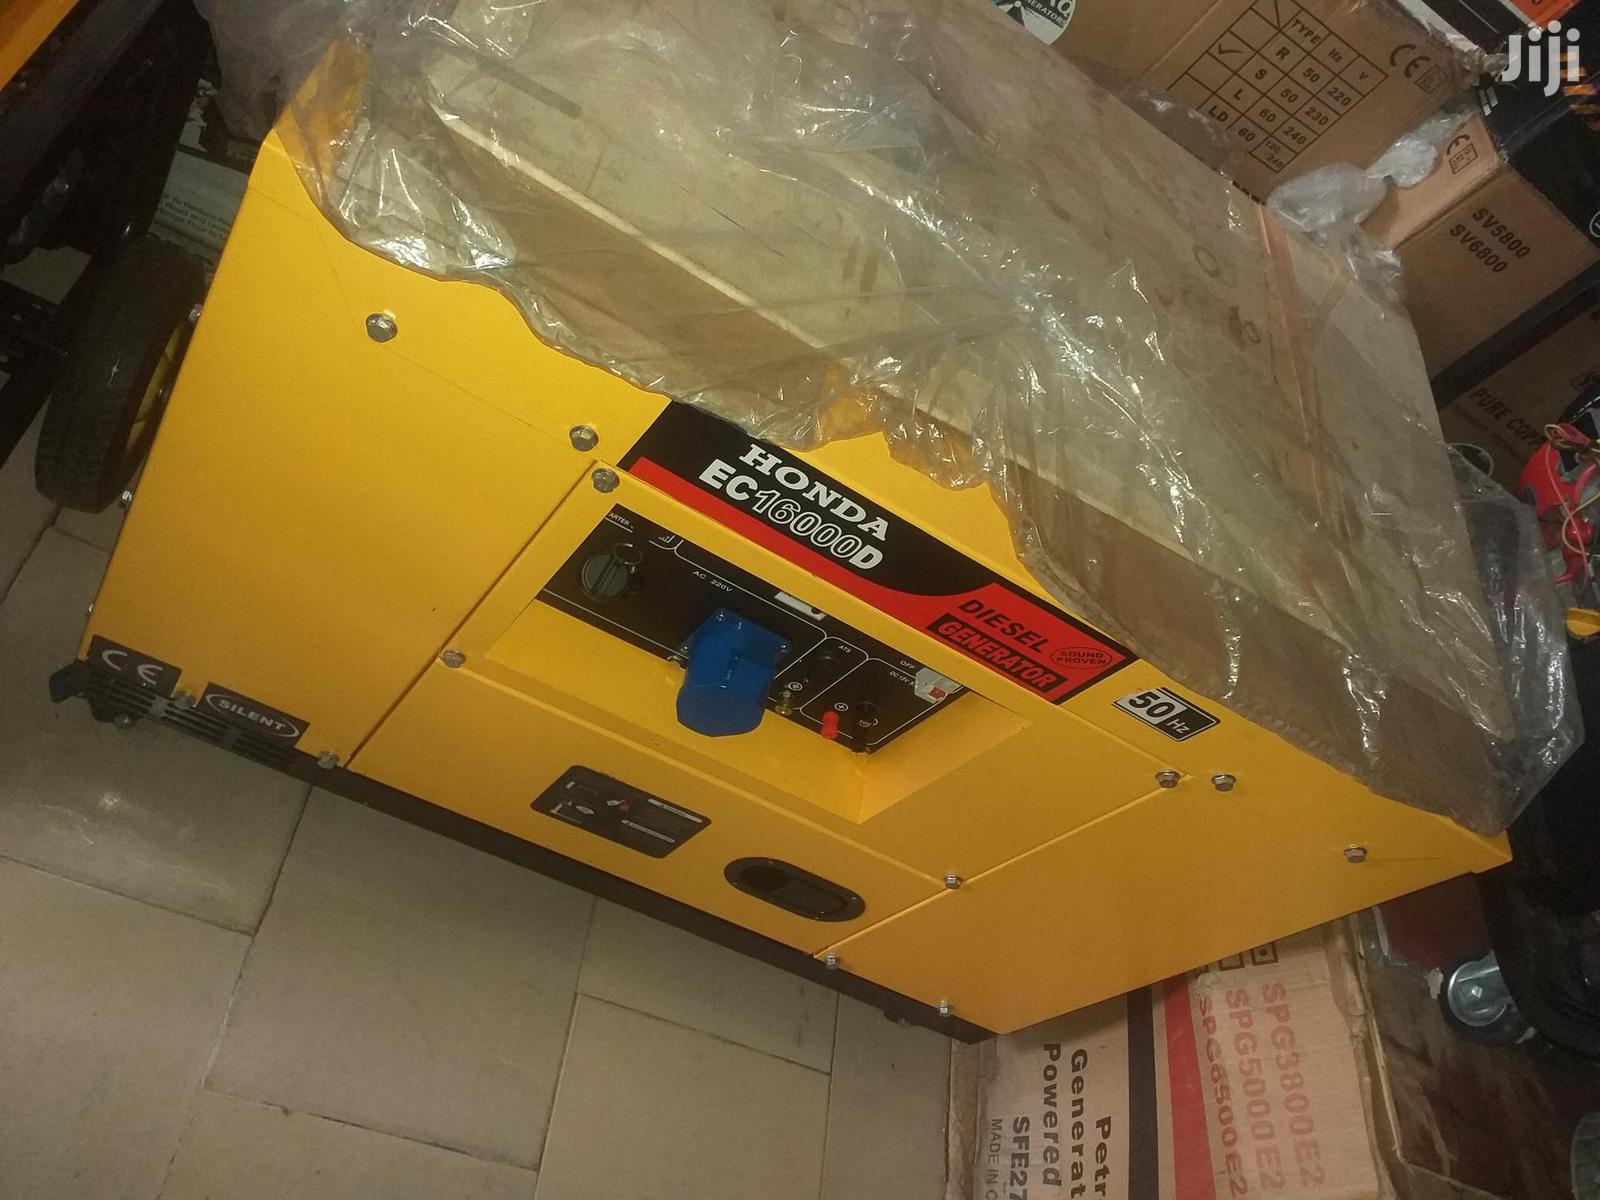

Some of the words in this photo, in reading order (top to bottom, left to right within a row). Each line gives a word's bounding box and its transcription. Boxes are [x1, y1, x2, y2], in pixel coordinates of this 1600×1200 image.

[1292, 18, 1321, 45] TYPE
[1328, 49, 1344, 64] Hz
[1254, 68, 1268, 81] S
[1304, 107, 1329, 126] 230
[1275, 46, 1290, 61] R
[1302, 67, 1321, 84] 50
[1327, 87, 1352, 107] 220
[1207, 105, 1228, 123] LD
[1232, 88, 1244, 101] L
[1259, 108, 1277, 123] 60
[1283, 126, 1307, 145] 240
[1450, 223, 1508, 273] SV6800
[1472, 207, 1531, 258] SV5800
[1471, 388, 1513, 422] PURE
[699, 458, 884, 570] EC16000D
[739, 443, 889, 542] HONDA
[692, 570, 706, 580] AC
[710, 579, 734, 593] 220V
[957, 599, 1050, 653] DIESEL
[101, 649, 164, 685] CE
[937, 617, 1057, 688] GENERATOR
[1060, 650, 1104, 659] SOUND
[217, 698, 288, 731] SILENT
[1127, 691, 1176, 720] 50
[1166, 718, 1190, 734] Hz
[1225, 988, 1286, 1190] SPG5000E2
[1262, 983, 1327, 1187] SPG3800E2
[986, 1118, 1003, 1164] MADE
[1043, 1043, 1062, 1187] Powered
[1070, 1049, 1088, 1199] Generat
[985, 1169, 999, 1185] IN
[1095, 1116, 1112, 1198] Petr
